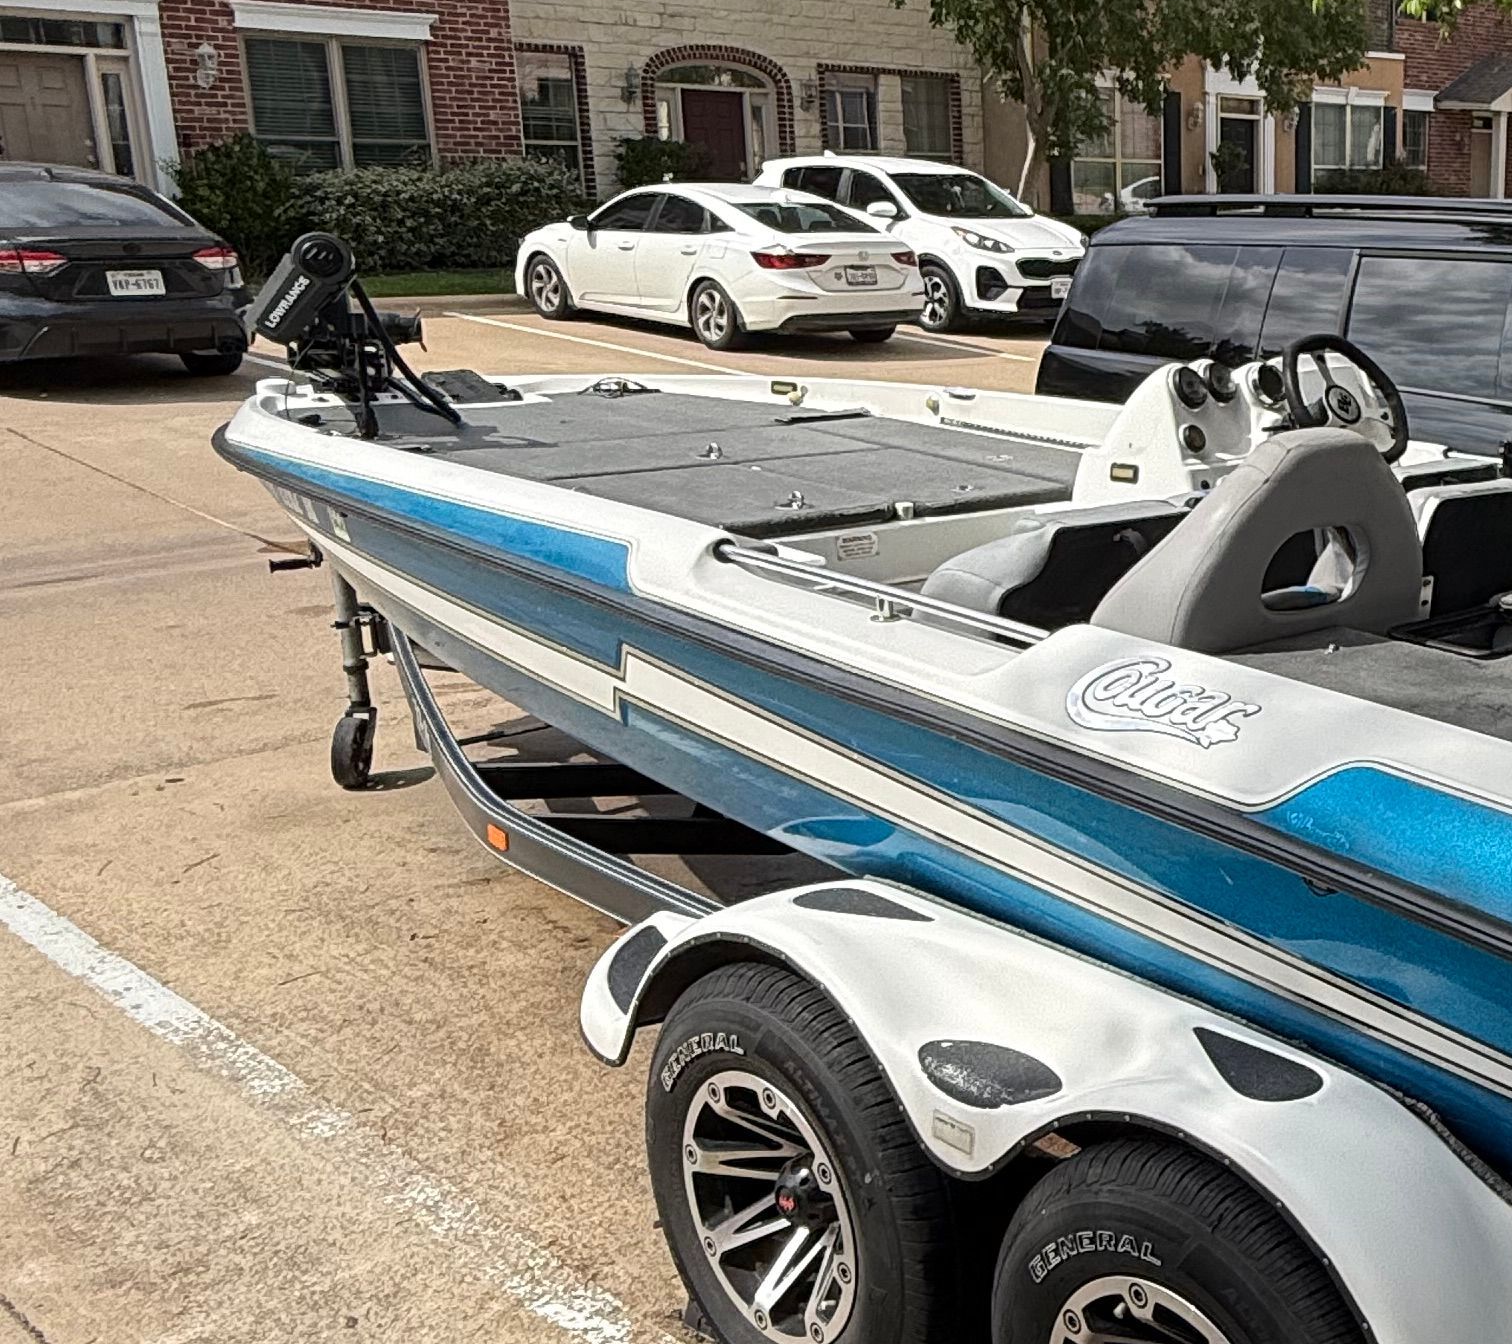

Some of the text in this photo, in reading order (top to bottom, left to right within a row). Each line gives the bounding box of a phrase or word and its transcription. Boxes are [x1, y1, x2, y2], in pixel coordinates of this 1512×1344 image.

[264, 275, 310, 328] LOWRANCE
[1065, 656, 1262, 747] Cougar
[660, 1032, 745, 1093] GENERAL
[1028, 1230, 1162, 1284] GENERAL
